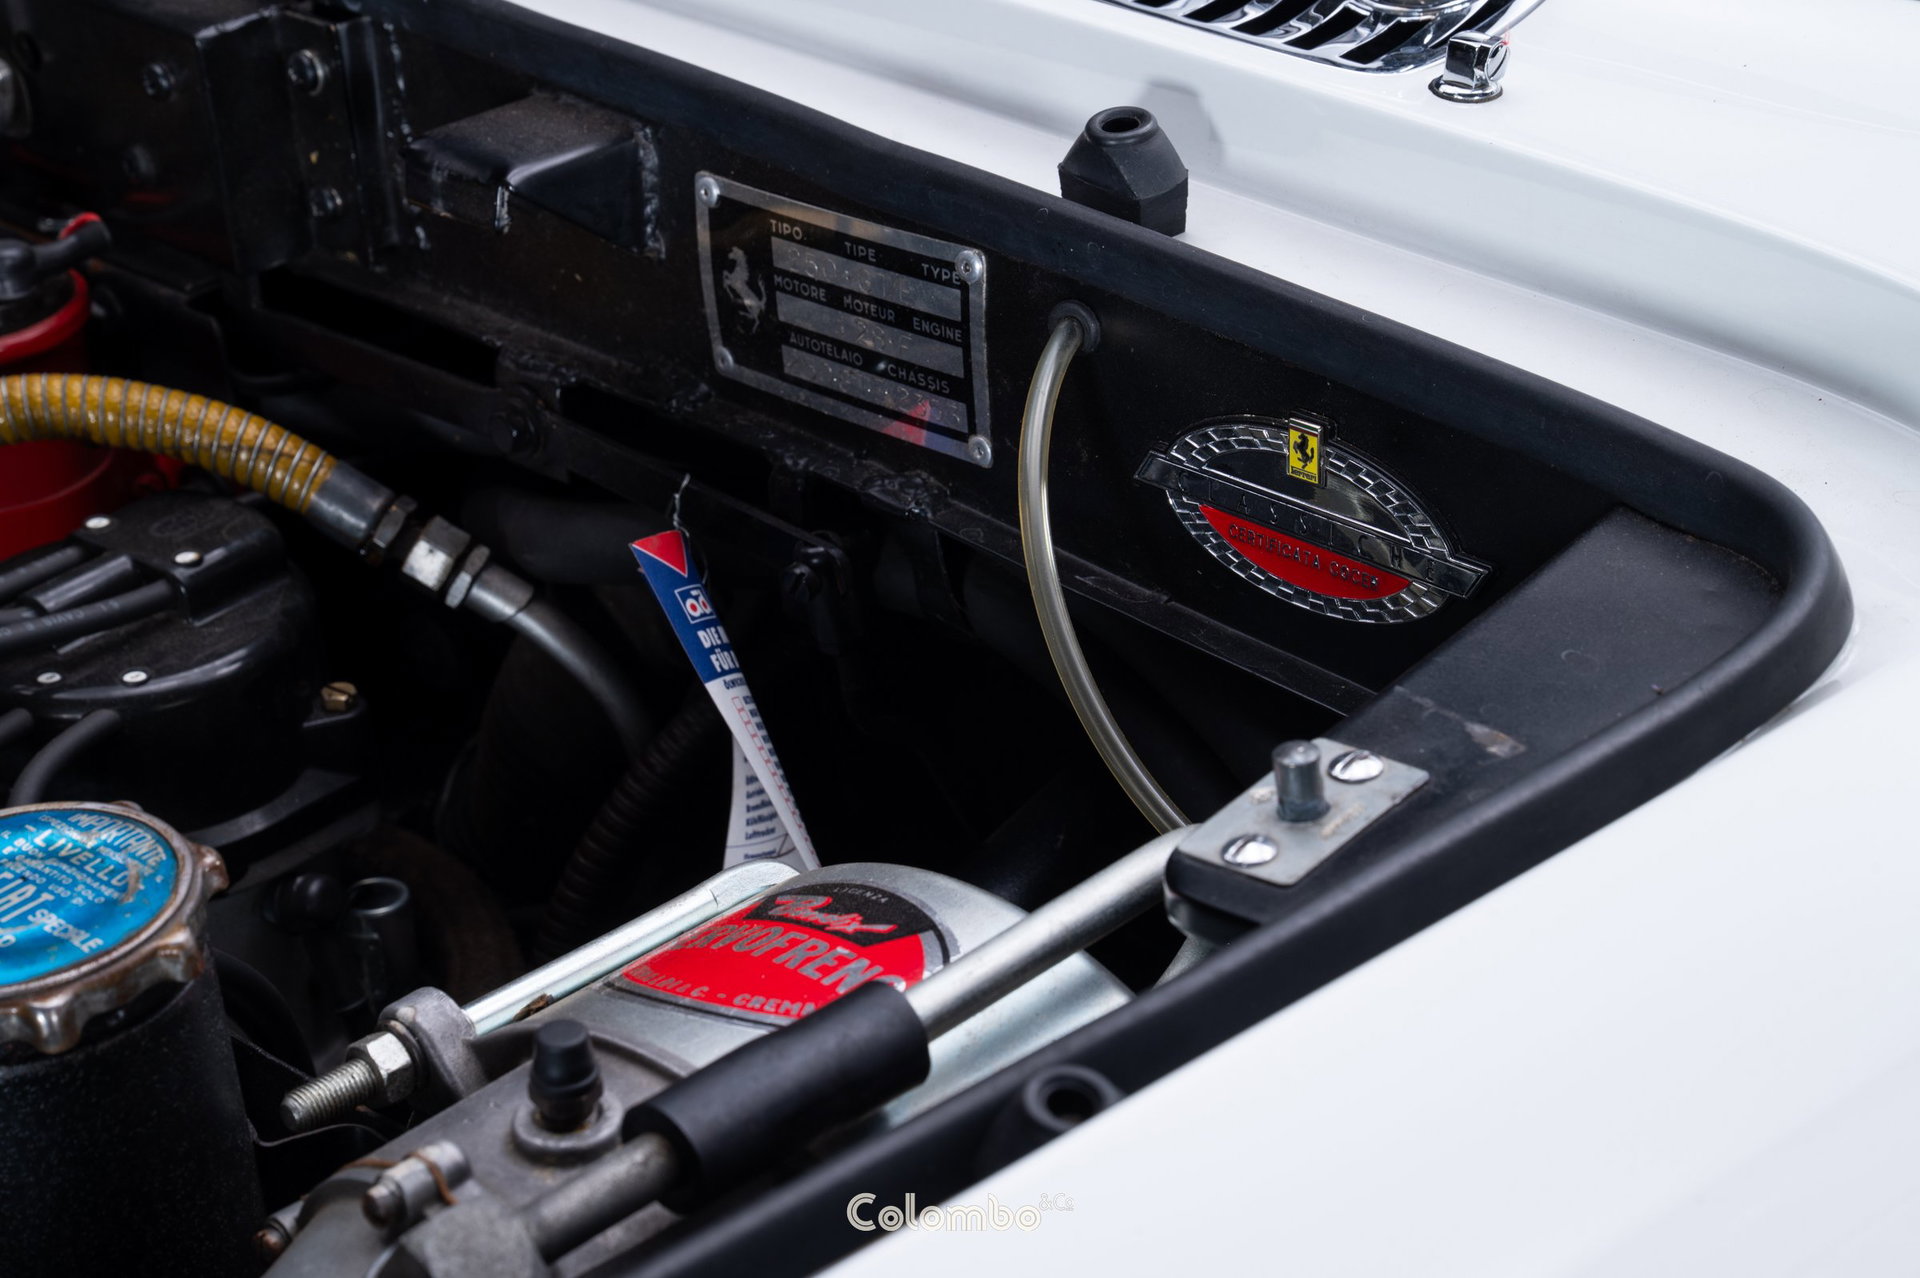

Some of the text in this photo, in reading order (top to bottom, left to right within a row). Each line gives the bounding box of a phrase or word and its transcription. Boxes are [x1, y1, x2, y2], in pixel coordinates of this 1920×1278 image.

[769, 219, 962, 285] TIPO TIPE TYPE
[774, 274, 963, 343] MOTORE MOTEUR ENGINE
[789, 331, 864, 367] AUTOTELAIO
[887, 363, 950, 394] CHASSIS
[1176, 470, 1437, 582] CLASSICHE
[1228, 523, 1380, 591] CERTIFICATA COCER
[33, 828, 130, 887] LIVELLO
[67, 812, 167, 867] IMPORTANTE
[73, 883, 106, 904] SOLO
[27, 908, 105, 954] SPECIALE
